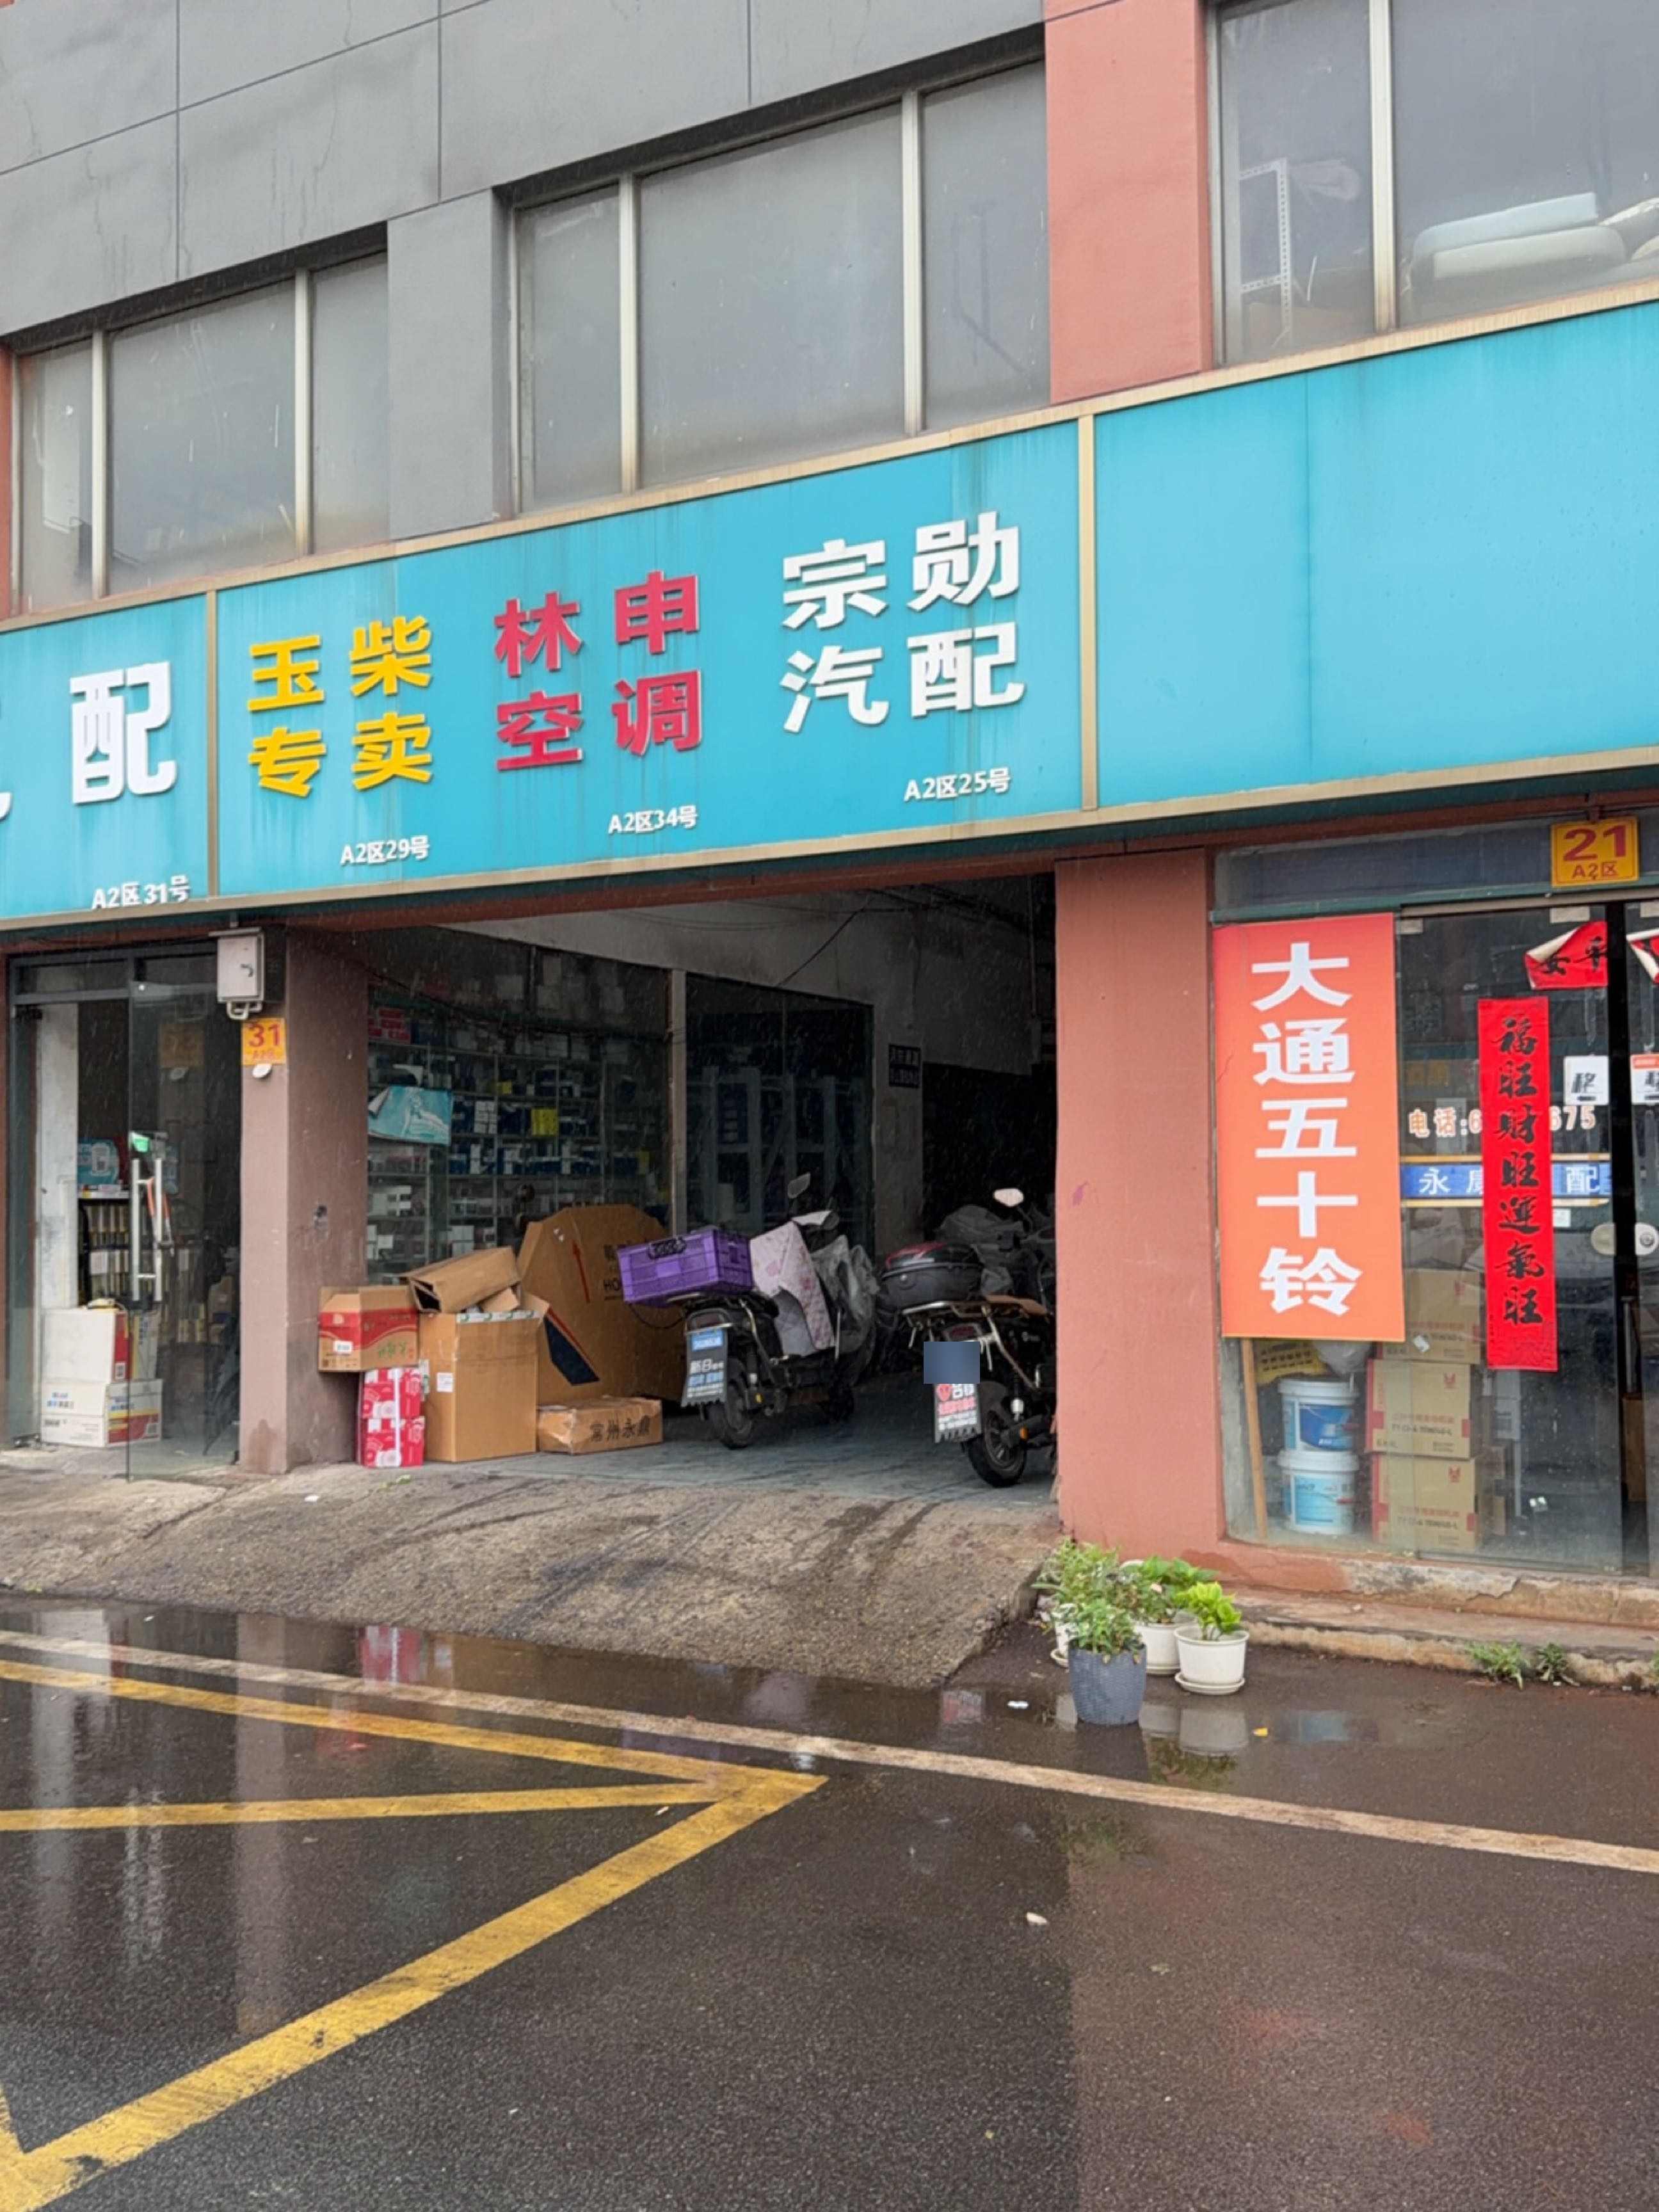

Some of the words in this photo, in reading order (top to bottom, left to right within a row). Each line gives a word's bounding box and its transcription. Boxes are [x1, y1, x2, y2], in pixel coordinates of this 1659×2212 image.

[782, 511, 1020, 630] 宗勋
[494, 571, 700, 678] 林申
[247, 615, 433, 713] 玉柴
[780, 621, 1025, 733] 汽配
[495, 669, 703, 771] 空调
[247, 712, 433, 798] 专卖
[904, 767, 1012, 802] A2区25号
[340, 835, 430, 866] A2区29号
[608, 805, 698, 835] A2区34号
[1563, 824, 1627, 862] 21
[91, 874, 191, 910] A2区31号
[1571, 860, 1619, 881] A2区
[248, 1022, 280, 1048] 31
[1251, 942, 1363, 1316] 大通五十铃
